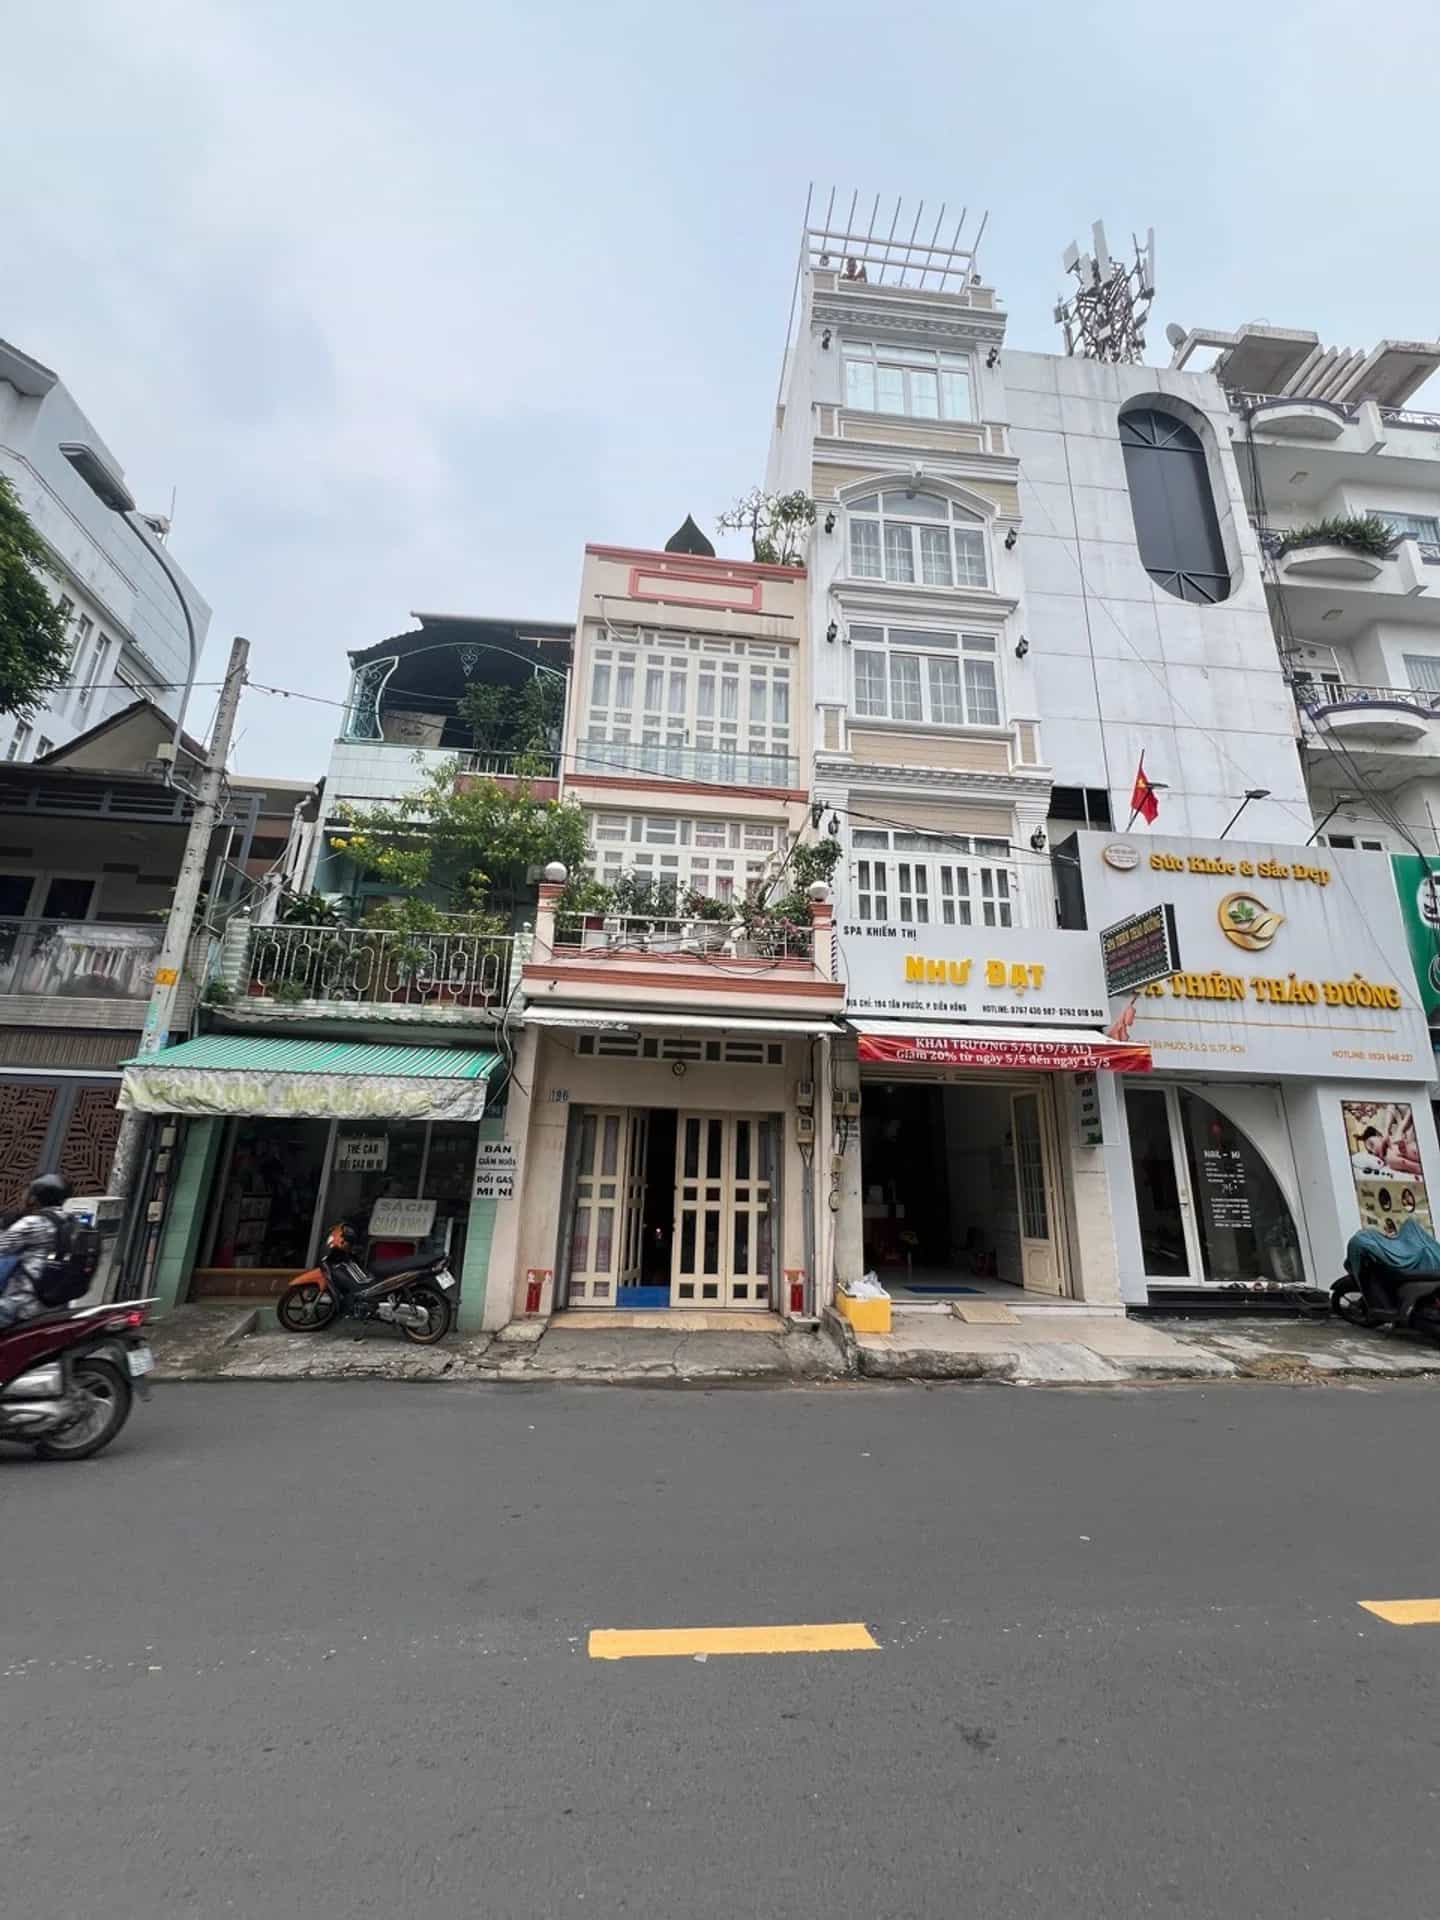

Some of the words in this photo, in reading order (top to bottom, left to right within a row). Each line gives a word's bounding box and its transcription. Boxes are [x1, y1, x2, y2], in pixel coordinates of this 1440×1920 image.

[1150, 852, 1184, 873] Sức
[1239, 860, 1254, 878] &
[1258, 859, 1290, 881] Sắc
[843, 925, 863, 937] SPA
[866, 922, 897, 938] KHIẾM
[901, 928, 917, 942] THỊ
[905, 955, 972, 986] NHƯ
[985, 960, 1045, 996] ĐẠT
[1166, 971, 1245, 1002] THIÊN
[1251, 973, 1321, 1006] THẢO
[915, 1037, 948, 1050] KHAI
[930, 1050, 957, 1062] 20%
[975, 1052, 1003, 1066] ngày
[1005, 1054, 1027, 1066] 5/5
[1053, 1056, 1080, 1069] ngày
[1082, 1056, 1111, 1069] 15/5
[476, 1187, 494, 1197] MI
[498, 1187, 513, 1197] NI
